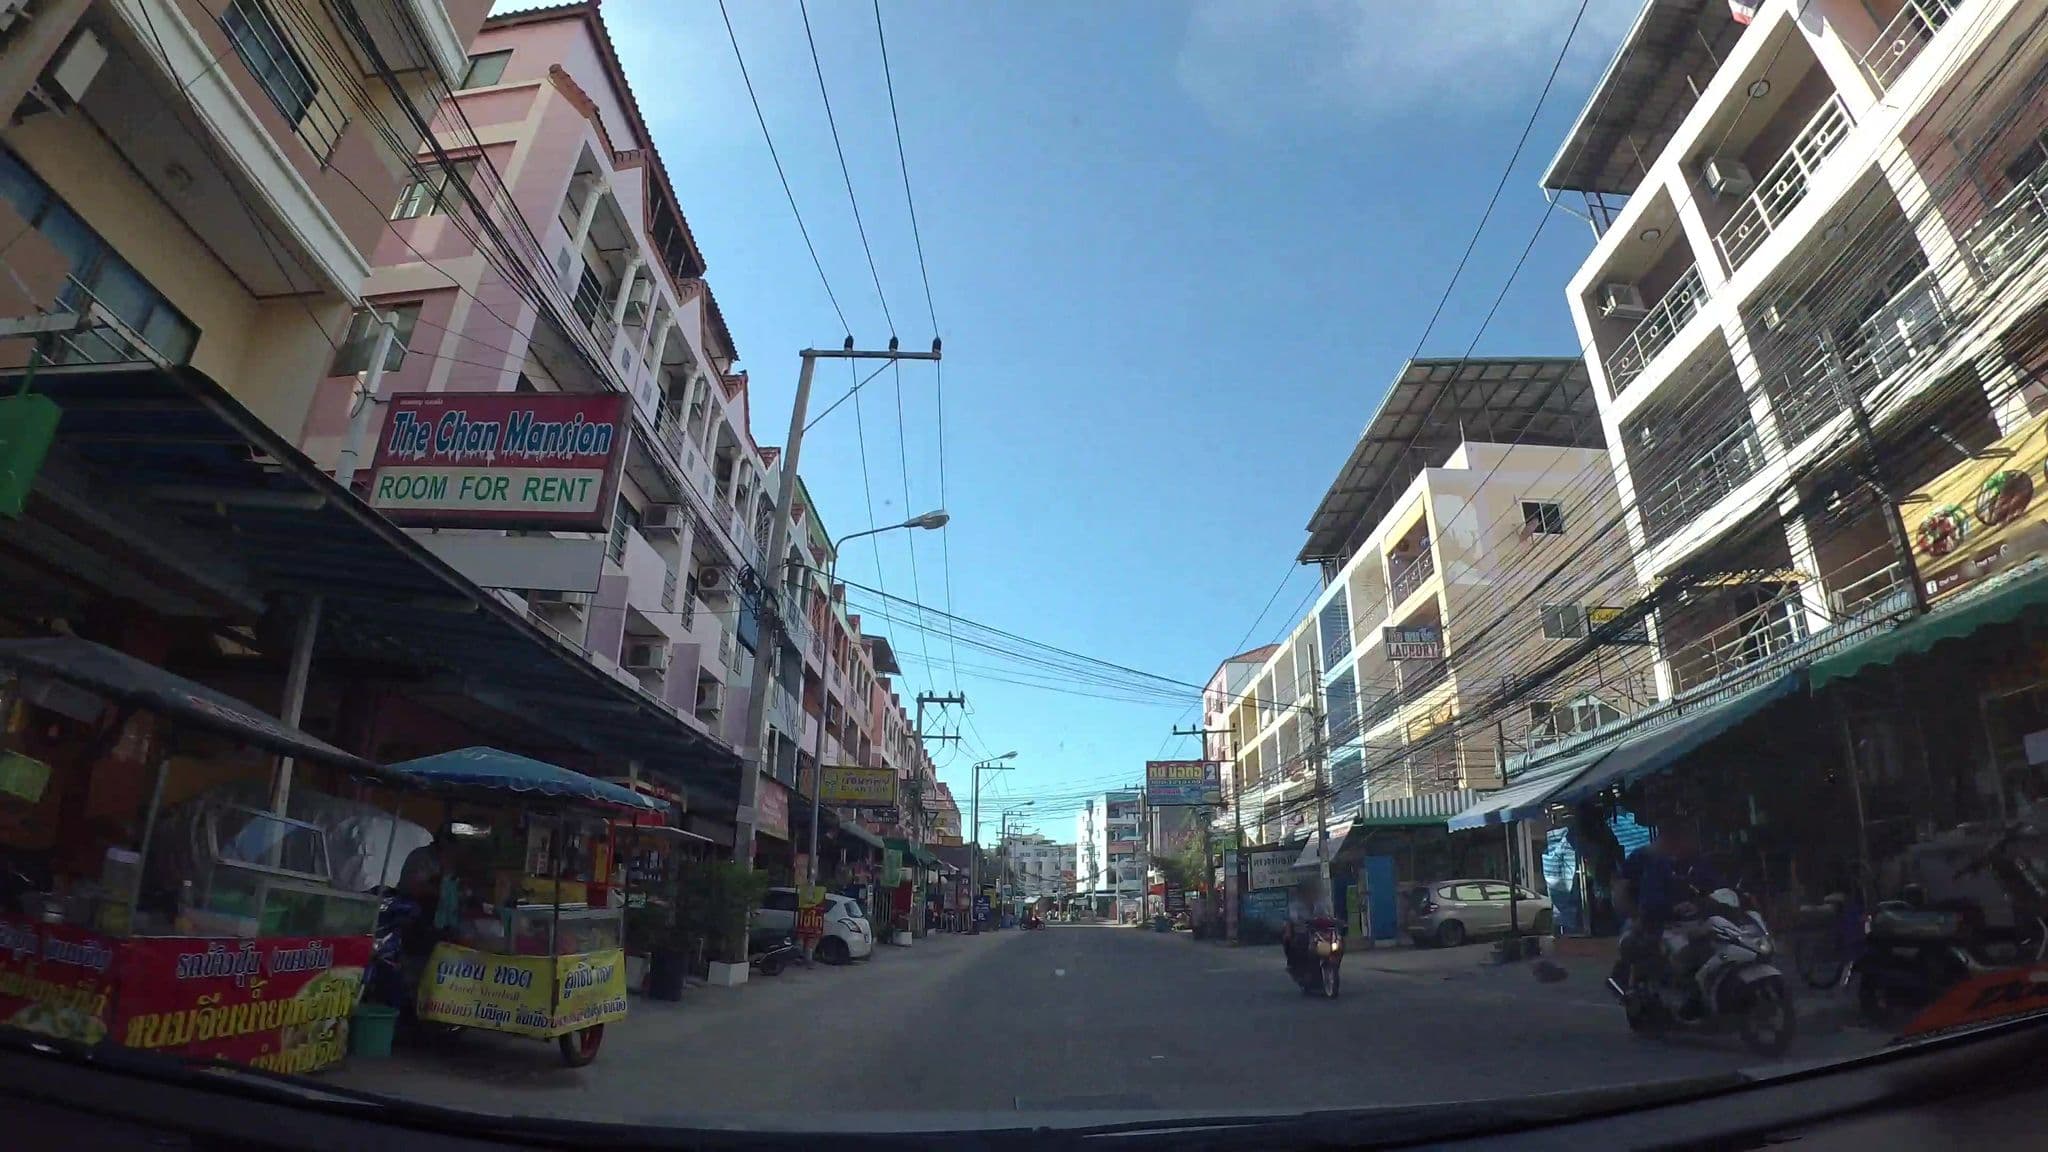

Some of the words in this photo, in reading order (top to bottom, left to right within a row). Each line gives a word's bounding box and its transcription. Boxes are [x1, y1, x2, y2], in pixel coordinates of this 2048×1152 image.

[388, 411, 432, 455] The
[435, 410, 500, 457] Chan
[502, 411, 613, 456] Mansion
[378, 475, 448, 501] ROOM
[459, 476, 510, 501] FOR
[522, 477, 593, 503] RENT
[1388, 643, 1436, 657] LAUNDRY
